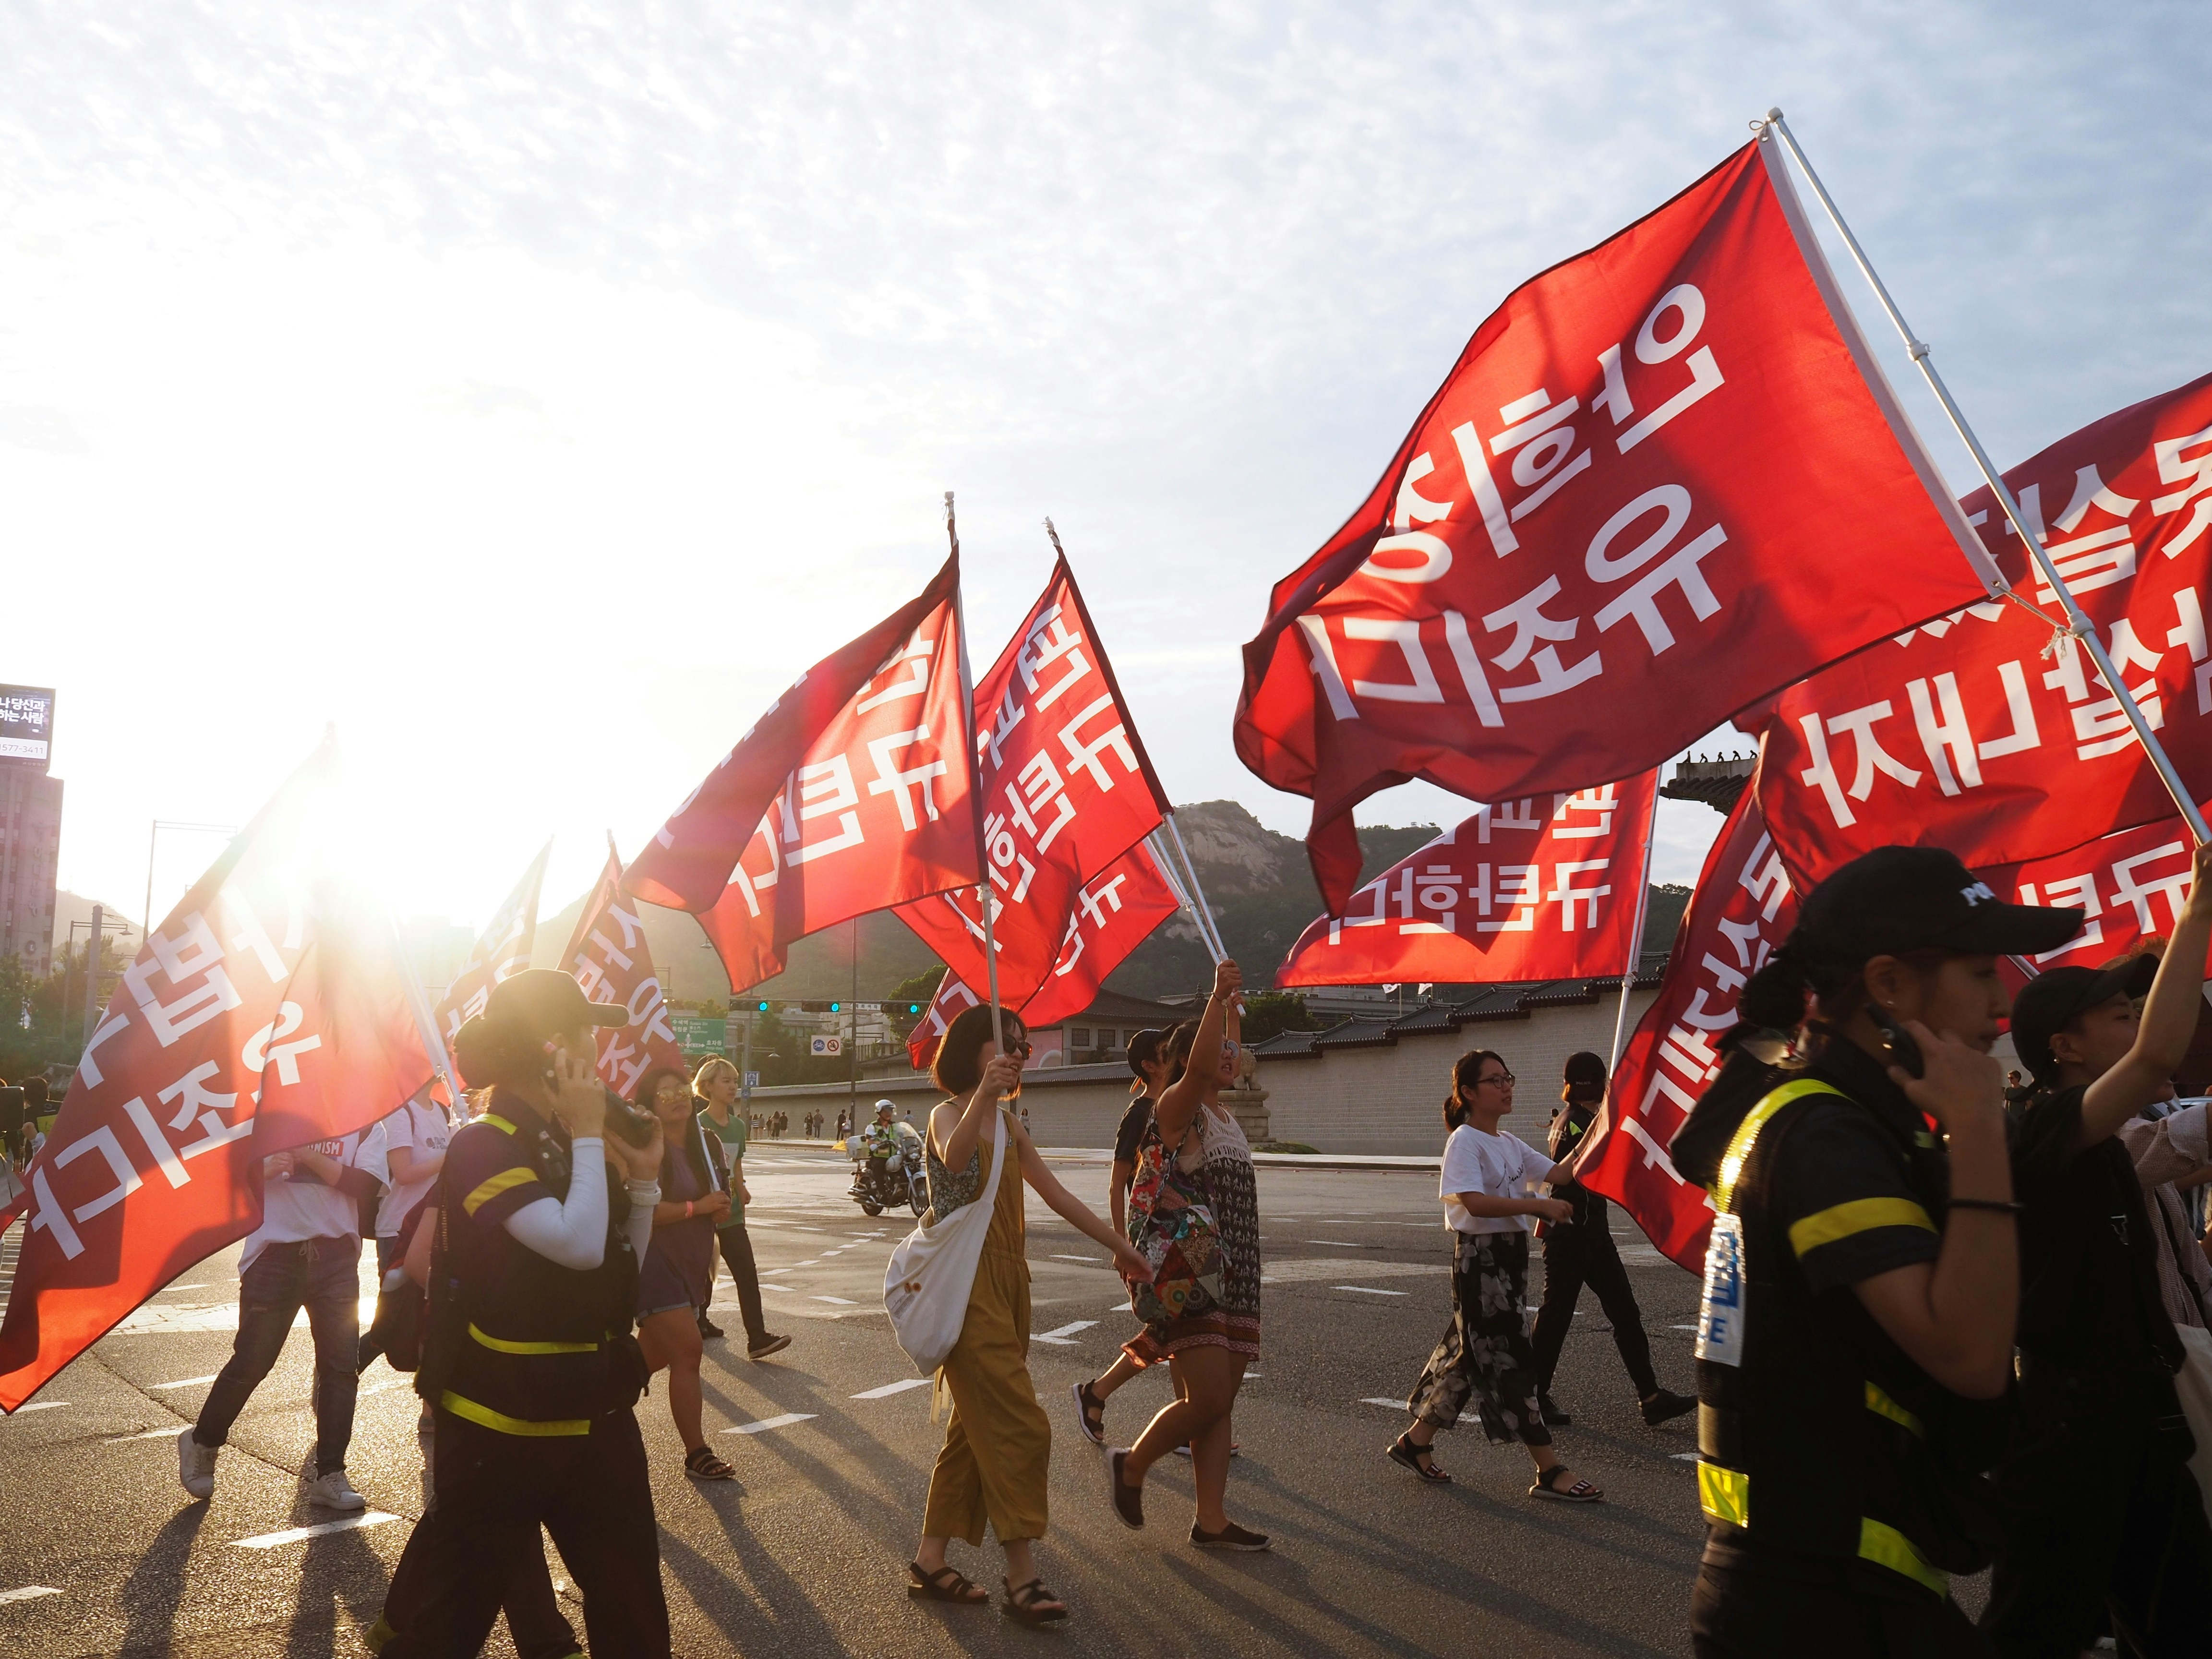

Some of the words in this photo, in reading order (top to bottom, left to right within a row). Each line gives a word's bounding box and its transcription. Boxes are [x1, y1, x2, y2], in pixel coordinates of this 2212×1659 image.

[11, 698, 46, 712] 당신과
[0, 709, 21, 722] 하는
[20, 711, 45, 725] 사람
